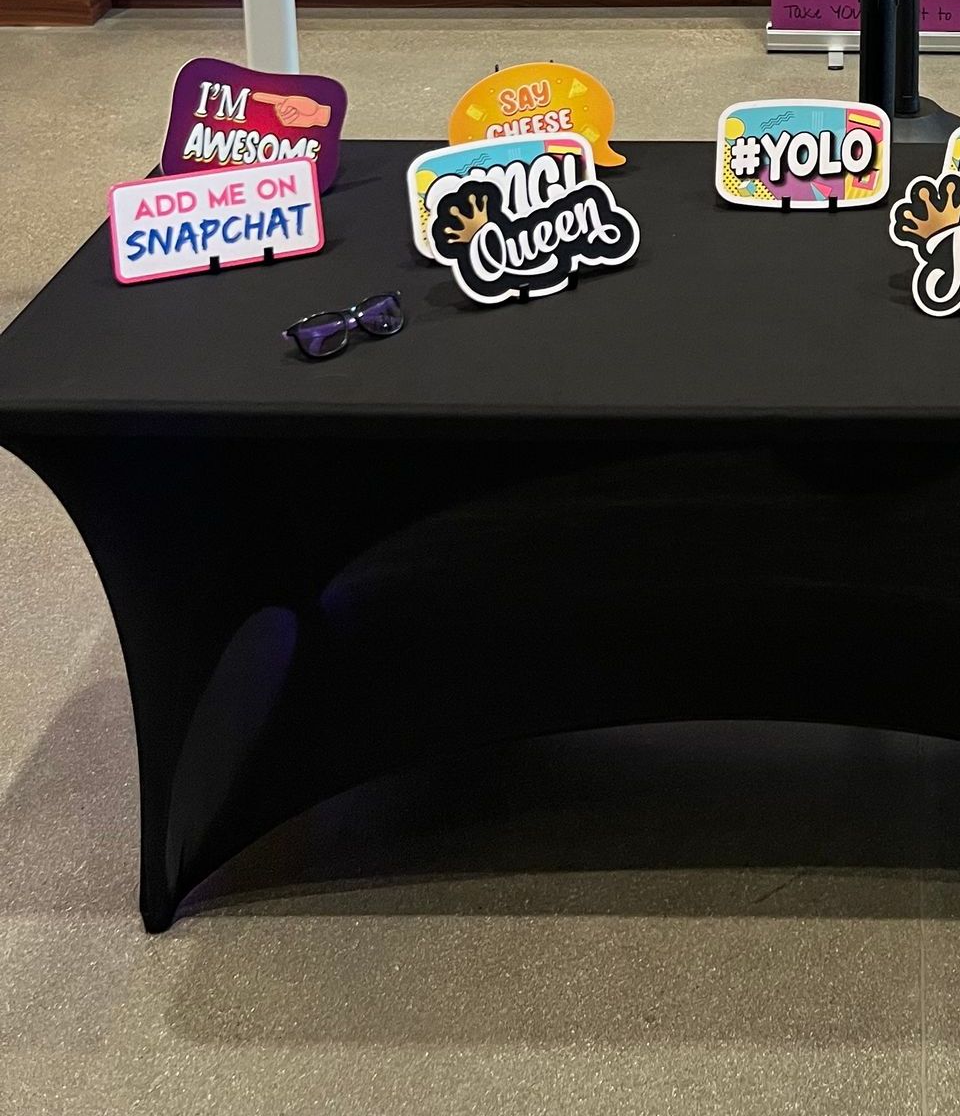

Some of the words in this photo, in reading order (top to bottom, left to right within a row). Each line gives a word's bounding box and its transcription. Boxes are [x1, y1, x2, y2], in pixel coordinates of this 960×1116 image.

[938, 7, 953, 21] to
[193, 81, 252, 123] I'M
[498, 79, 552, 117] SAY
[182, 122, 321, 166] AWESOME
[486, 108, 574, 140] CHEESE
[730, 127, 874, 183] #YOLO
[134, 191, 198, 221] ADD
[208, 182, 246, 209] ME
[256, 175, 298, 201] ON
[126, 203, 311, 262] SNAPCHAT
[468, 197, 621, 282] Queen
